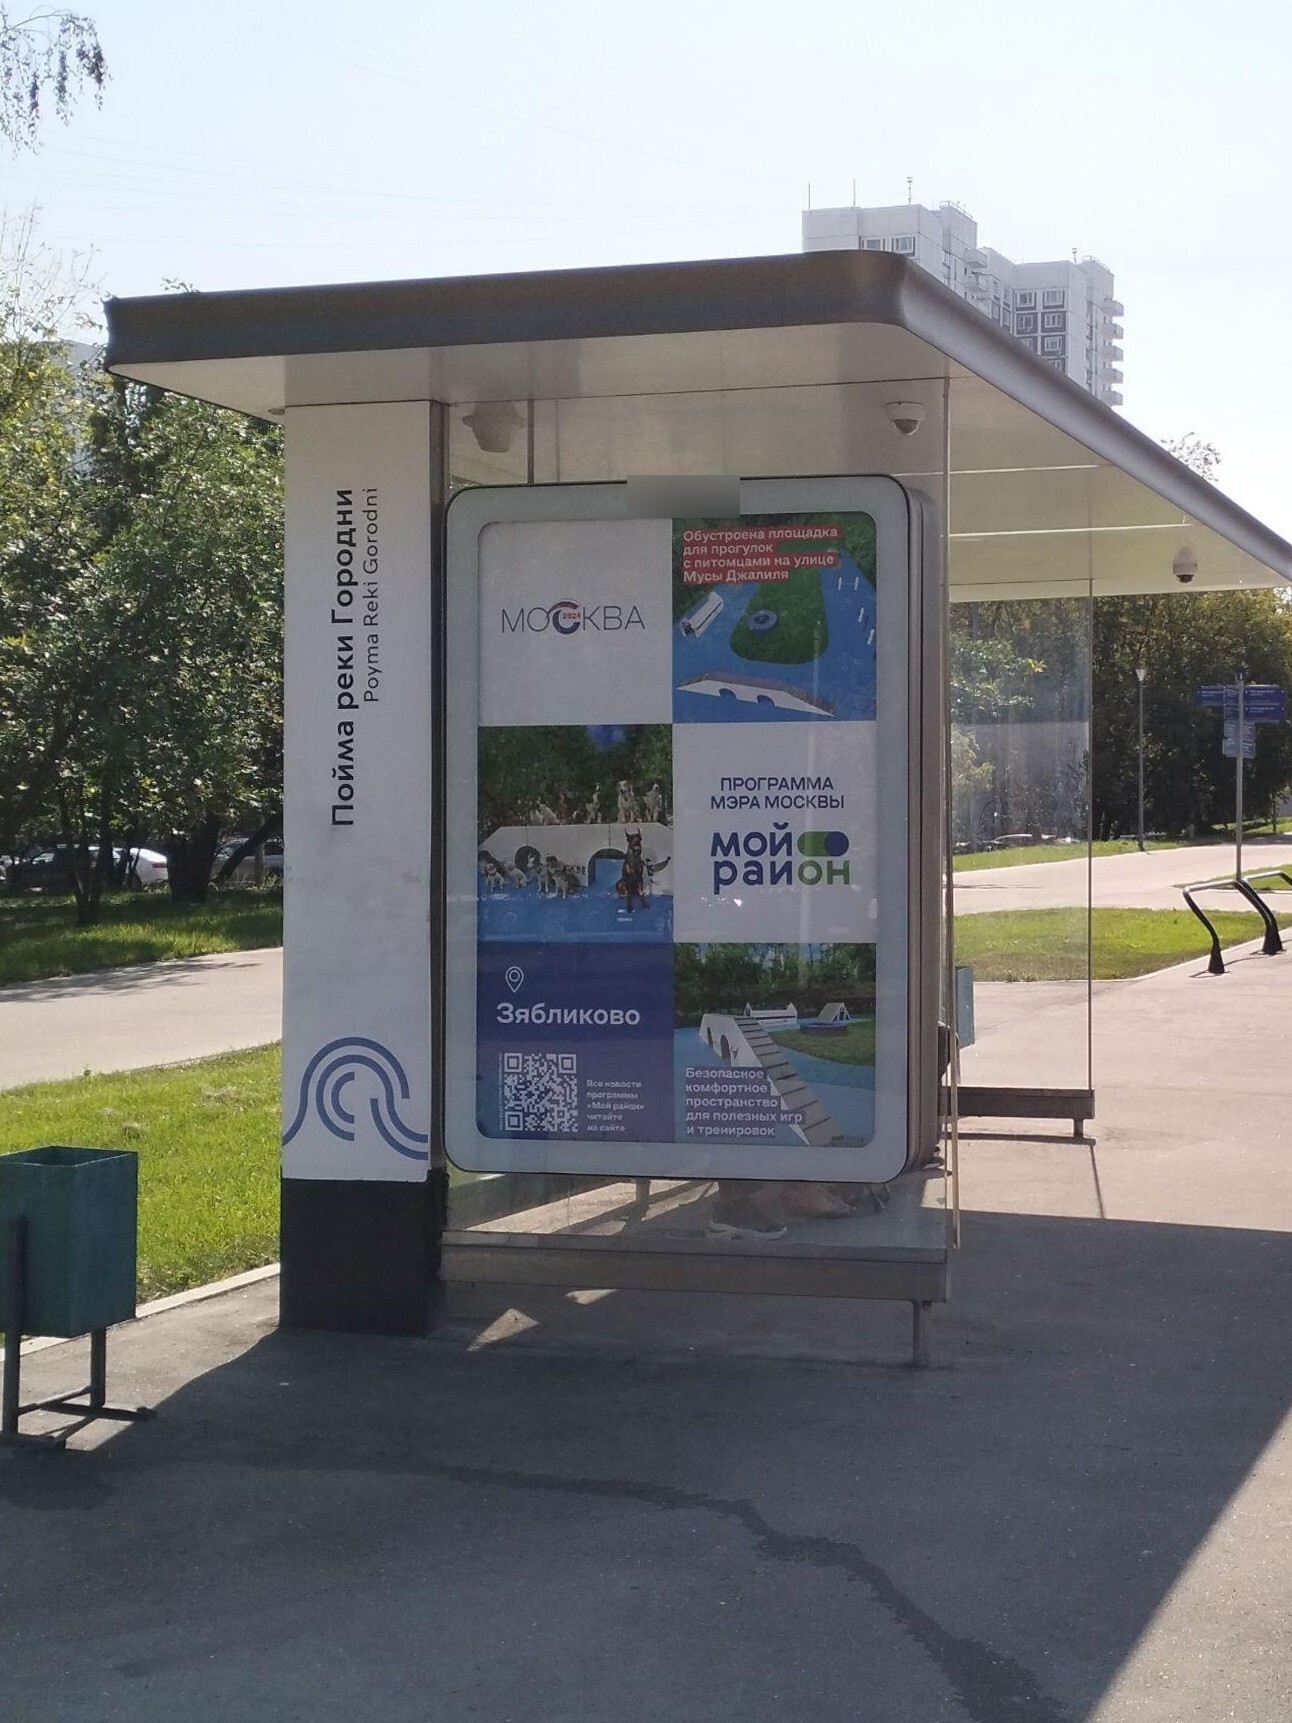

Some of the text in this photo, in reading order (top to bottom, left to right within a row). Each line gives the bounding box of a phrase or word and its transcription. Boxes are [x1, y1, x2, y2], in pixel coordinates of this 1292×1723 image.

[683, 526, 838, 543] Обустроена площадка
[683, 544, 774, 557] для прогулок
[683, 555, 835, 570] с питомцами на улице
[683, 569, 789, 585] Мусы Джалиля
[363, 487, 383, 702] Poyma Reki Gorodni
[501, 599, 646, 636] МОСКВА
[331, 489, 359, 826] Пойма реки Городни
[720, 776, 835, 791] ПРОГРАММА
[710, 794, 845, 810] МЭРА МОСКВЫ
[496, 1002, 641, 1026] Зябликово
[685, 1067, 765, 1079] Безопасное
[586, 1079, 603, 1088] Все
[685, 1082, 768, 1095] комфортное
[685, 1097, 778, 1109] пространство
[685, 1111, 803, 1124] для полезных игр
[686, 1126, 776, 1137] и тренировок
